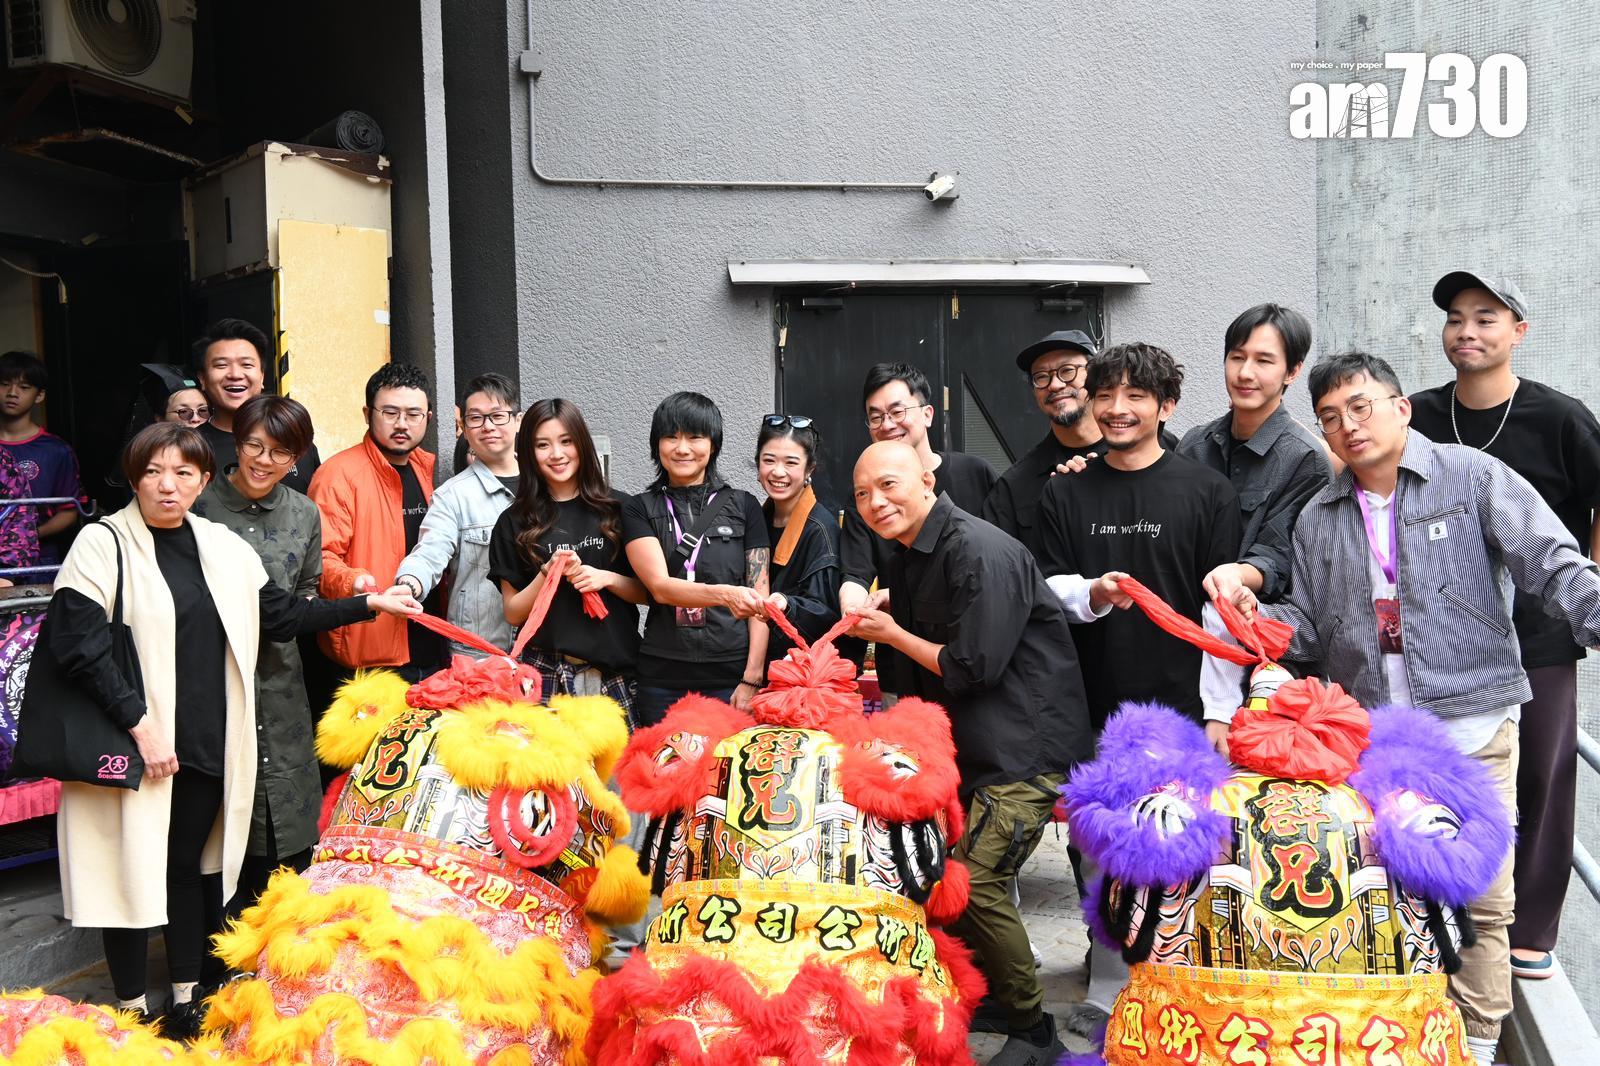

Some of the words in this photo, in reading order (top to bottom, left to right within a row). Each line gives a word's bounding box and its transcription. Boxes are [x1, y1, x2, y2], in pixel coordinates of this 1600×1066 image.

[547, 542, 553, 554] I
[1090, 523, 1097, 535] I
[1099, 525, 1117, 534] am
[1120, 518, 1162, 538] working
[365, 708, 438, 788] 群兄
[741, 731, 804, 827] 群兄
[1250, 781, 1338, 911] 群兄
